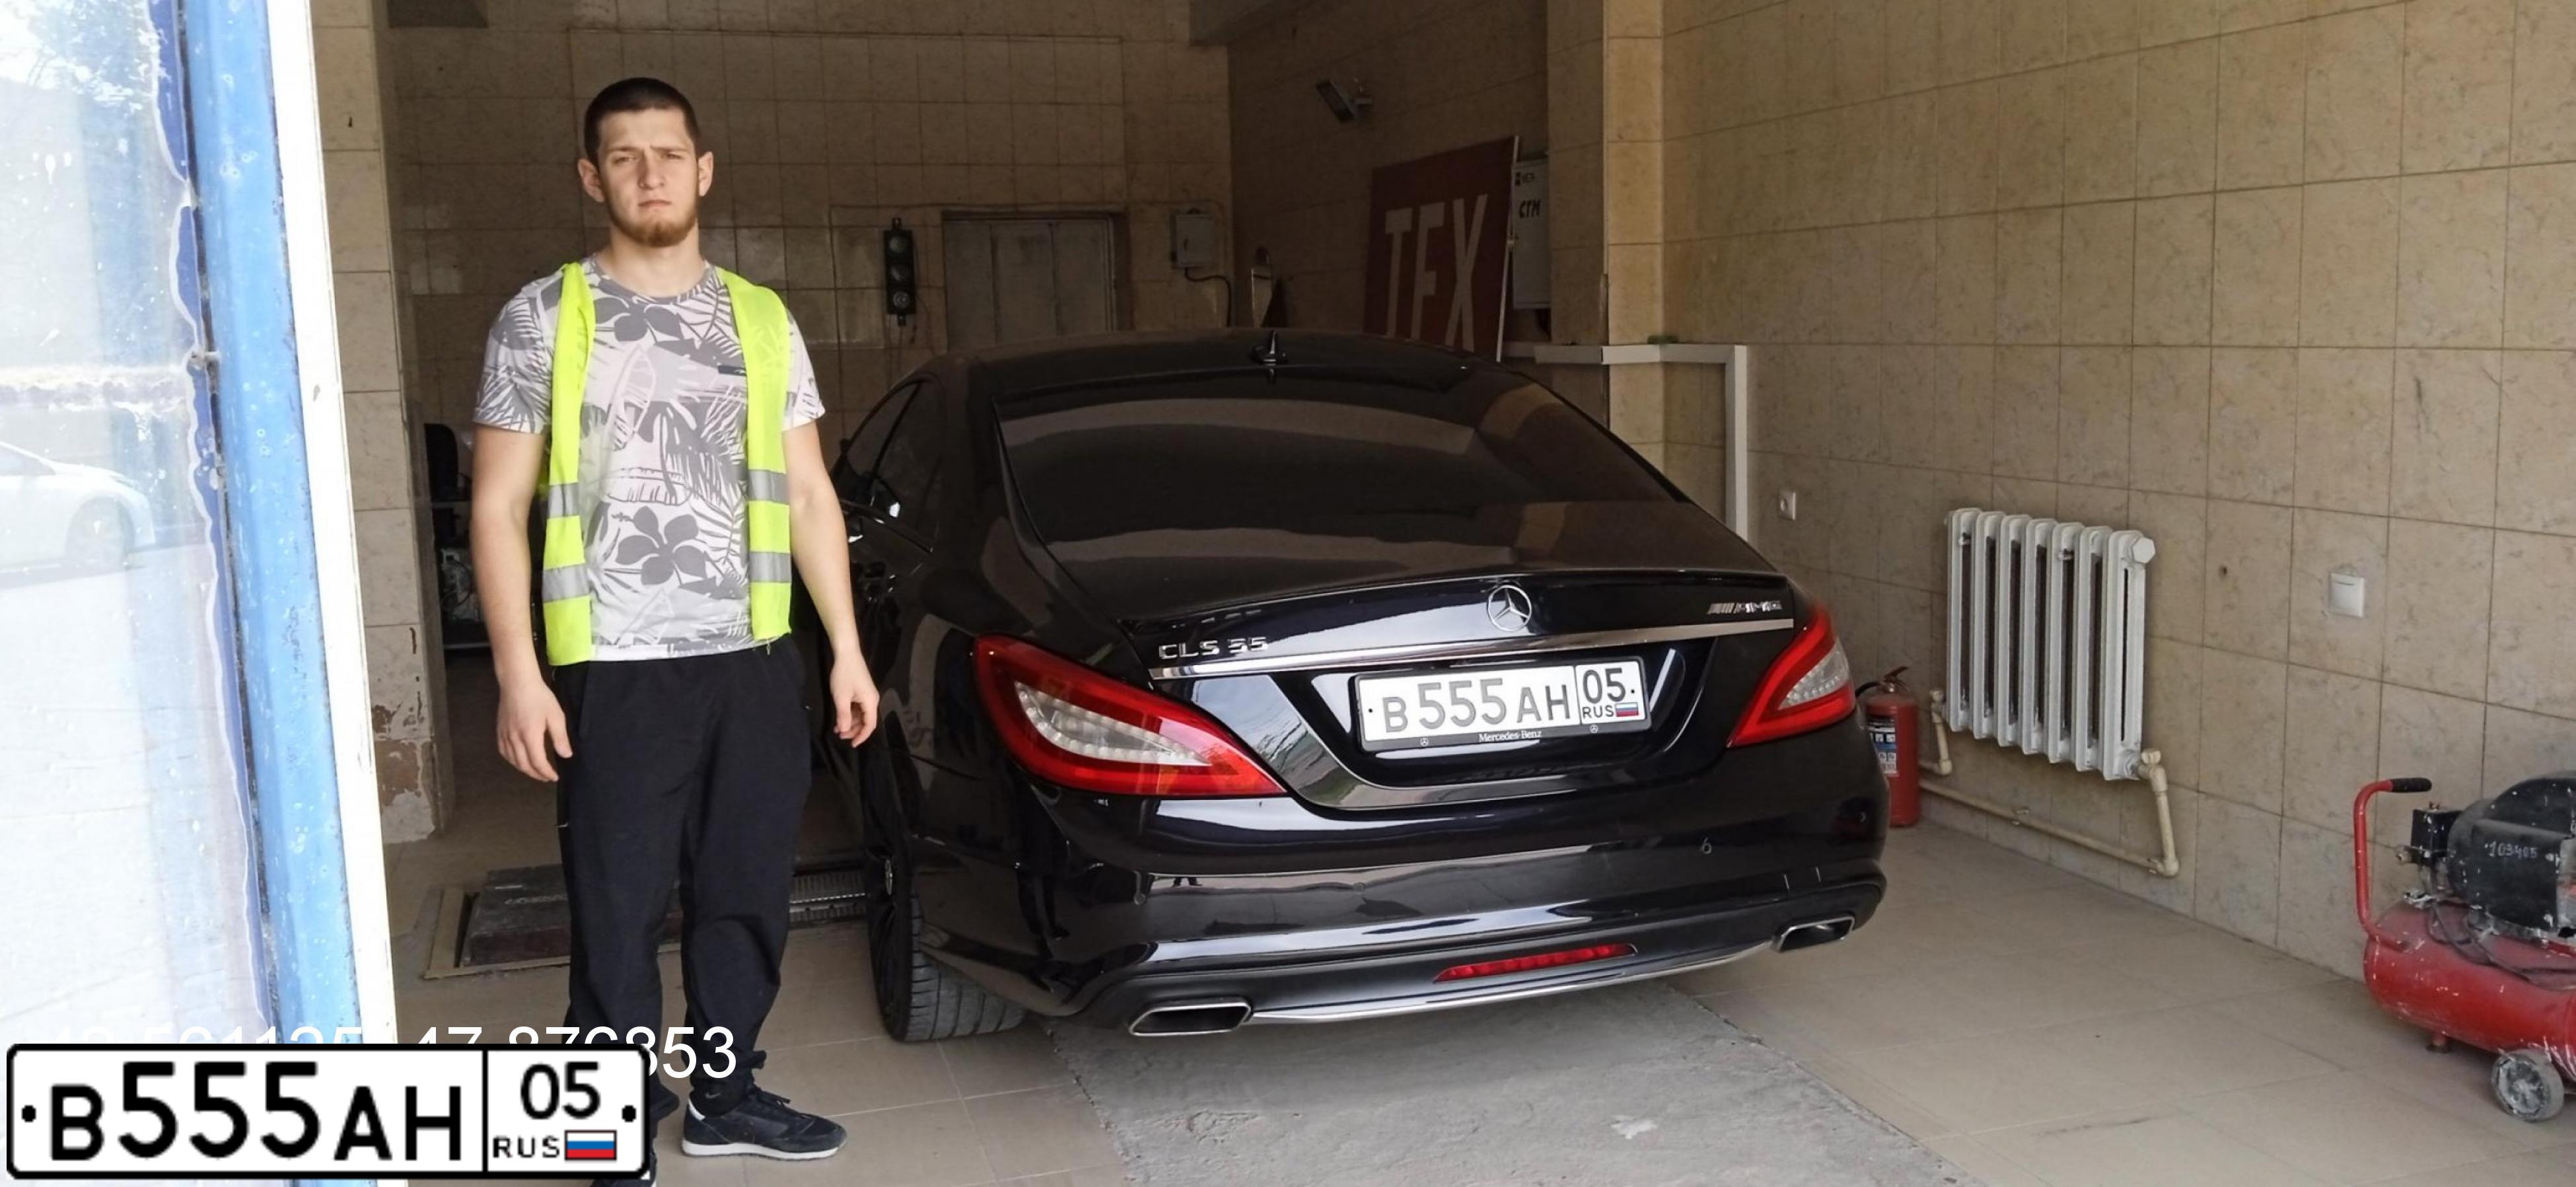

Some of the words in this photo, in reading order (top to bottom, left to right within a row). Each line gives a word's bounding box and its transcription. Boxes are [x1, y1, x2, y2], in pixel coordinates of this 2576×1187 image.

[1159, 640, 1221, 660] CLS
[1583, 667, 1626, 703] 05
[1582, 706, 1615, 718] RUS
